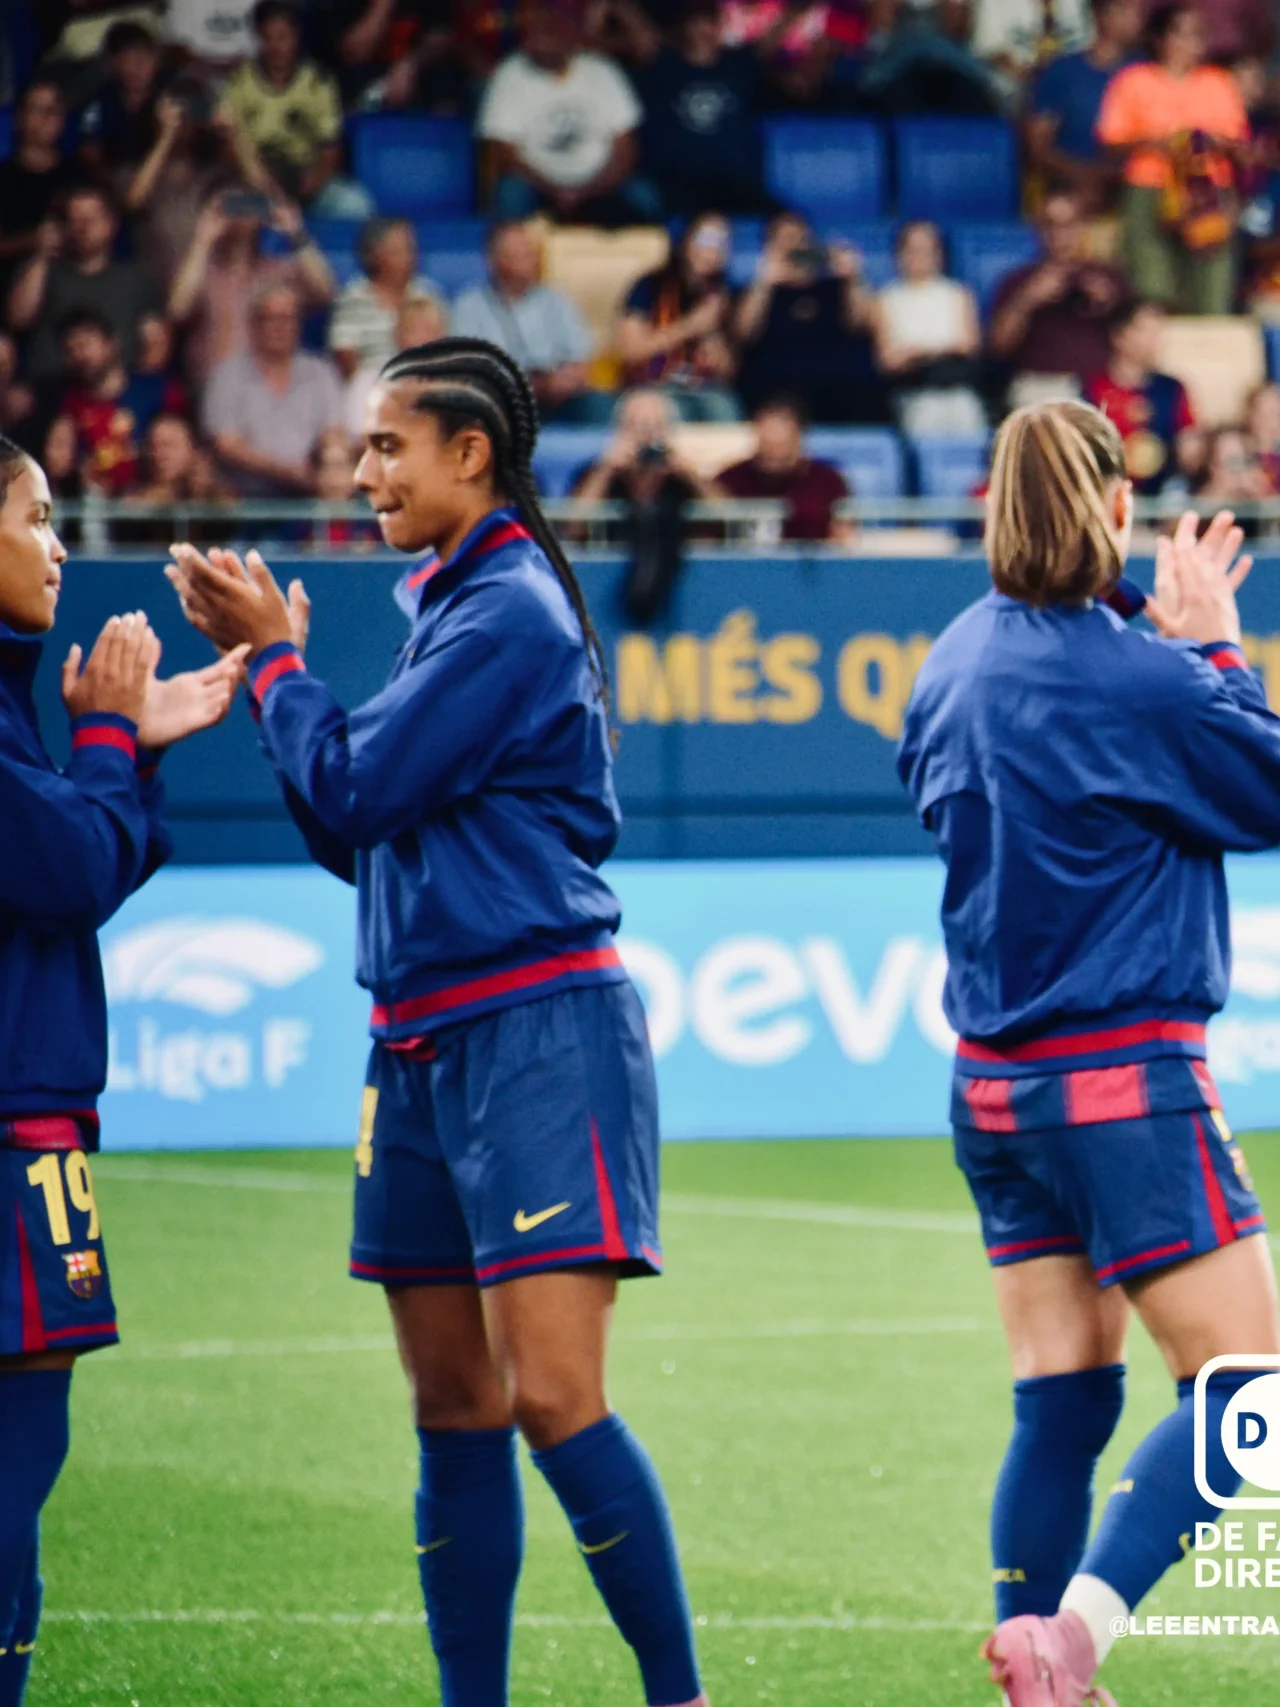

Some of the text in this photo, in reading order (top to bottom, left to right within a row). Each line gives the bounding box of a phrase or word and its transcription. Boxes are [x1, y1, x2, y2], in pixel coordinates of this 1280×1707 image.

[616, 608, 823, 724] MÉS
[261, 1016, 312, 1090] F
[26, 1148, 101, 1246] 19
